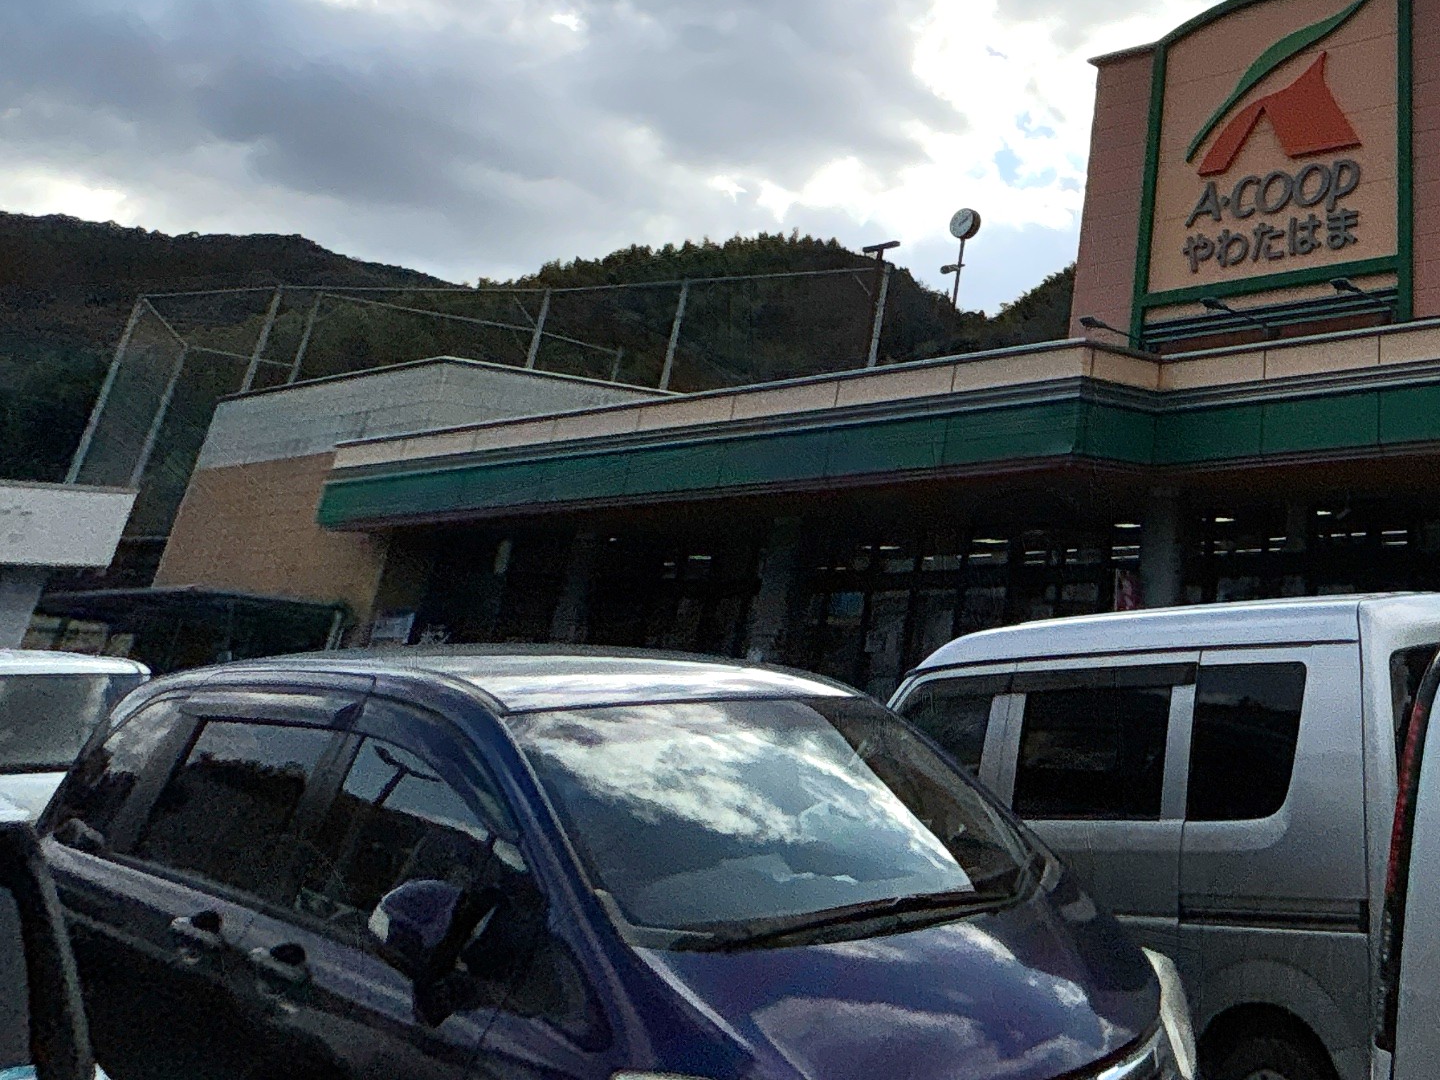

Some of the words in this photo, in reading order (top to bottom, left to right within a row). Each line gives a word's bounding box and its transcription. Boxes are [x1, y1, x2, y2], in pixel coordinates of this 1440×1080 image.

[1183, 208, 1360, 273] やわたはま
